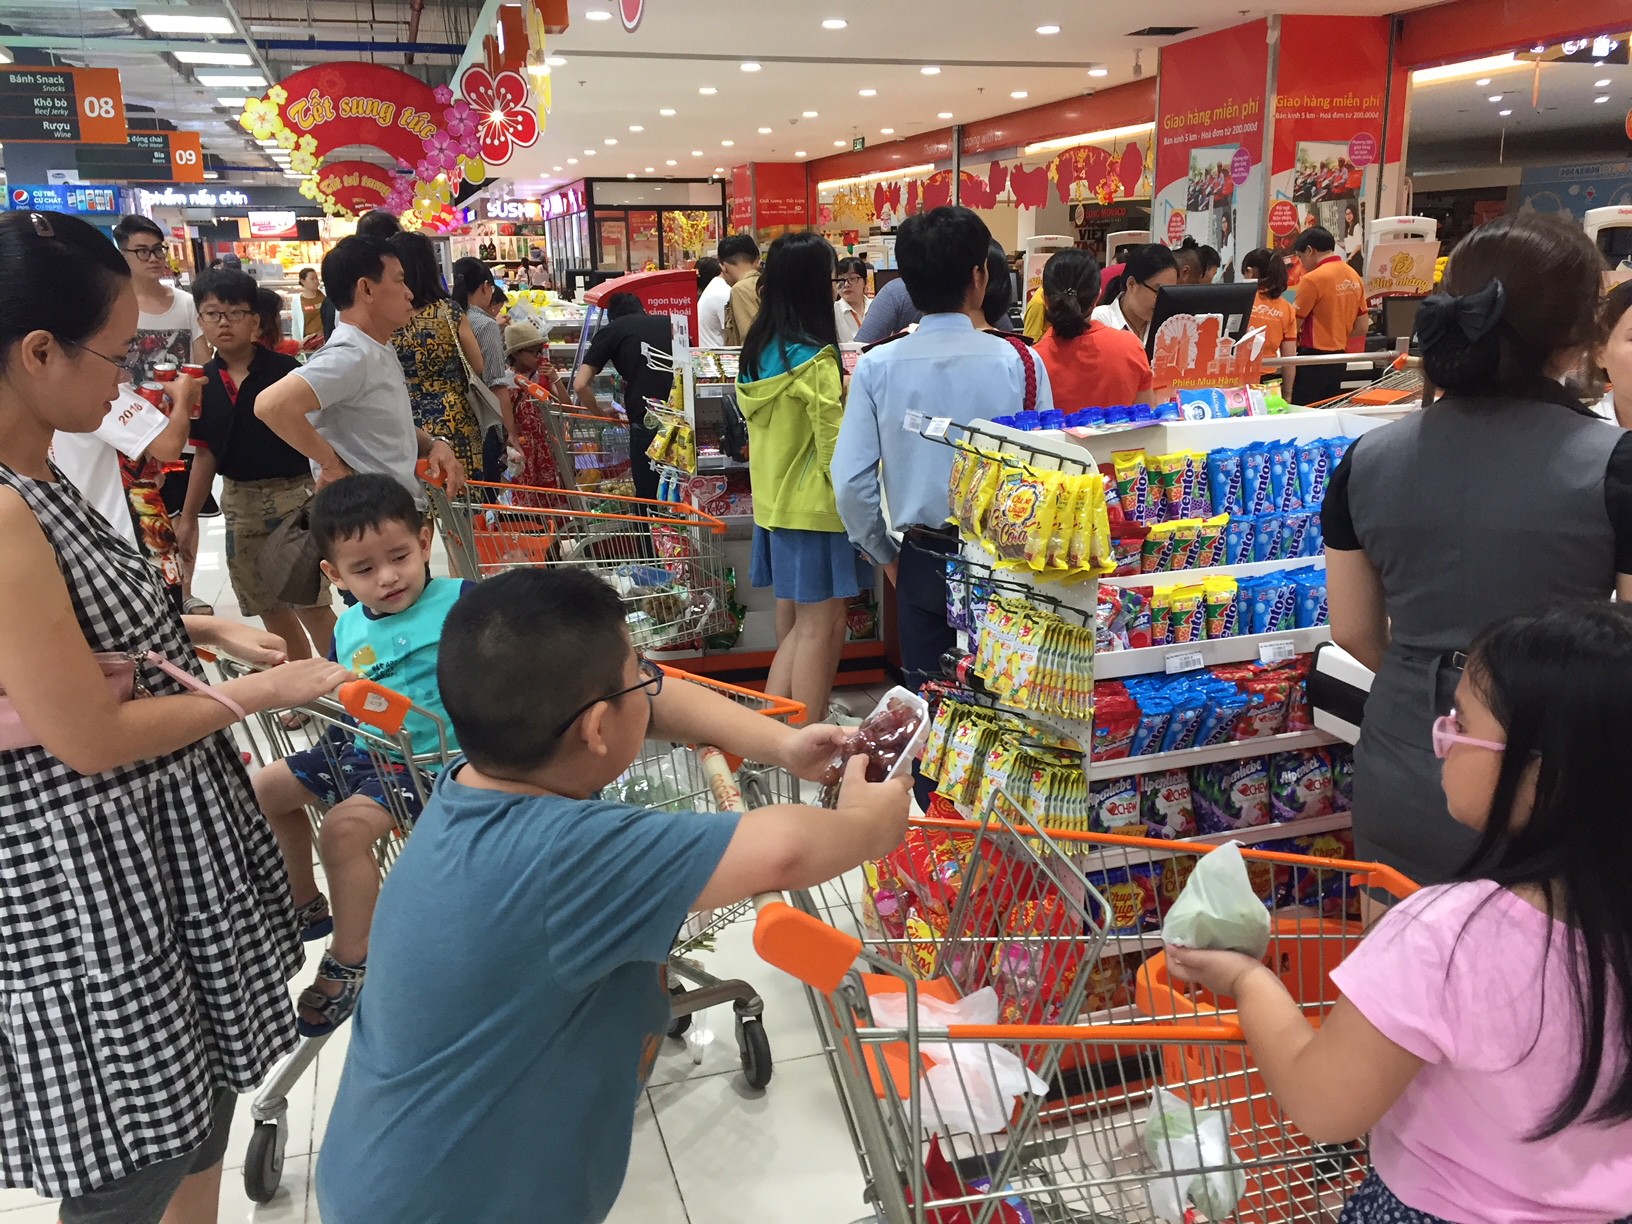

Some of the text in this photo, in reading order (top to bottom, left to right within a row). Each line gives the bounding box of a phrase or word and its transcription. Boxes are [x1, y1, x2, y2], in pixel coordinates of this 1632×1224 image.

[9, 74, 65, 84] Bánh Snack
[33, 98, 67, 107] Khô bò
[84, 96, 115, 118] 08
[1276, 91, 1380, 110] Giao hàng miễn phí
[35, 108, 69, 117] Beef Jerky
[286, 88, 438, 140] Tết sung túc
[1163, 95, 1260, 130] Giao hàng miễn phí
[1353, 111, 1379, 119] 200.000đ
[43, 121, 70, 131] Rượu
[1189, 133, 1198, 141] km
[175, 149, 196, 165] 09
[647, 296, 691, 307] ngon tuyệt
[1172, 376, 1239, 387] Phiếu Mua Hàng
[118, 401, 144, 427] 2018
[1000, 522, 1028, 545] Cola
[1221, 592, 1238, 639] entos
[1107, 802, 1137, 816] 2CHEW
